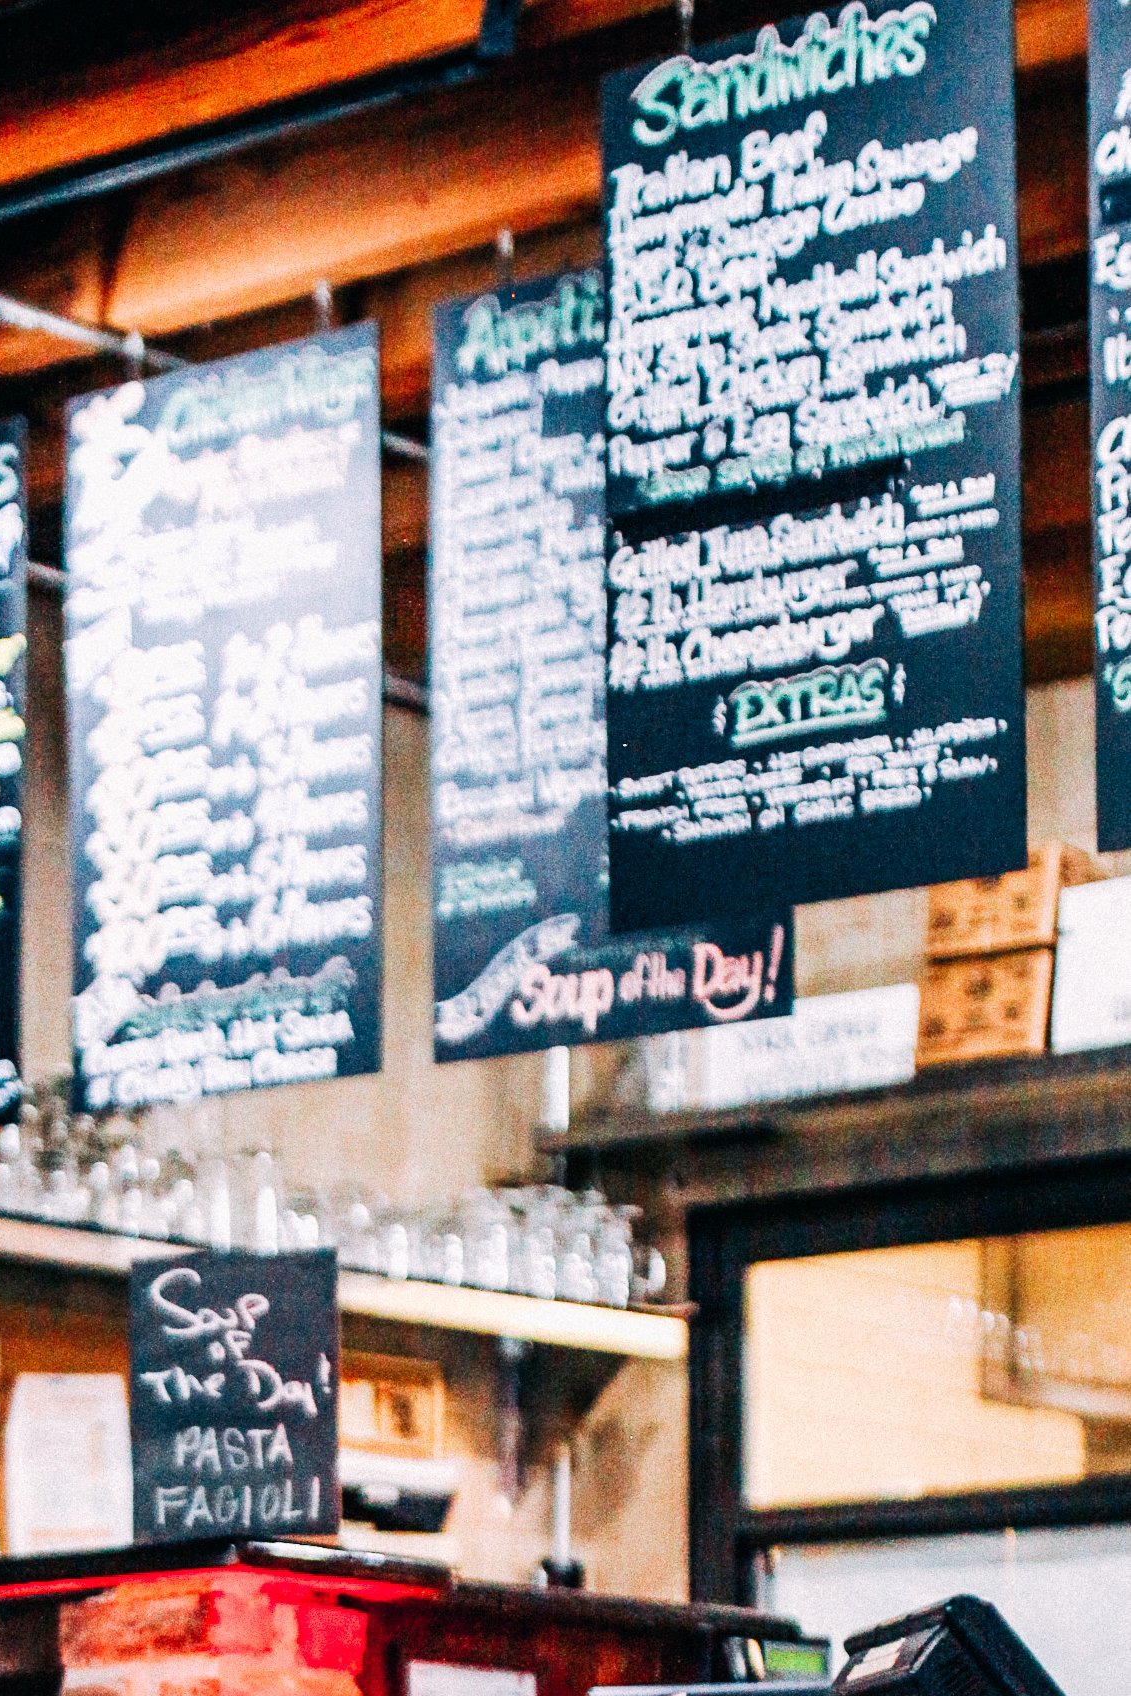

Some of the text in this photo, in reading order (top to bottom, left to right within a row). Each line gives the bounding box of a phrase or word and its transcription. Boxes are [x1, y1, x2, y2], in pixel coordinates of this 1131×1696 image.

[630, 1, 937, 145] Sandwiches
[611, 110, 827, 215] Italian Beef
[855, 127, 978, 192] Sausage
[822, 180, 925, 236] Combo
[878, 224, 1007, 285] Sandwich
[456, 275, 606, 372] Appeti
[815, 288, 953, 348] Sandwich
[608, 530, 700, 592] Grilled
[769, 492, 906, 567] Sandwich
[681, 603, 885, 680] Cheeseburger
[730, 657, 890, 737] EXTRAS
[511, 964, 615, 1034] Soup
[692, 924, 785, 1023] Day!
[151, 1267, 270, 1337] Soup
[174, 1422, 293, 1472] PASTA
